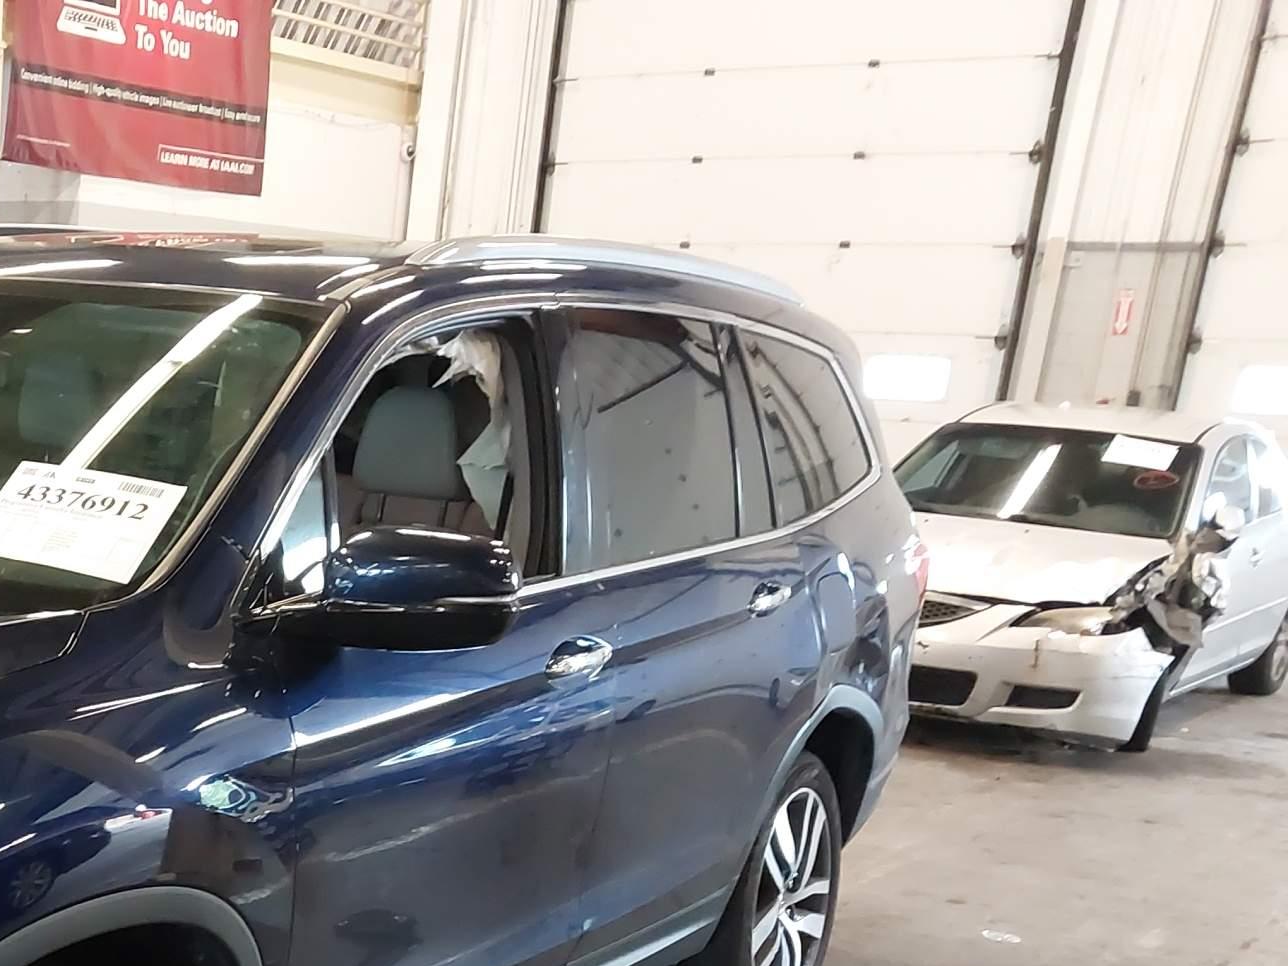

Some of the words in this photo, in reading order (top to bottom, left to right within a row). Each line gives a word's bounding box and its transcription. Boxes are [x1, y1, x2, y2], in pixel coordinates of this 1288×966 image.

[137, 0, 169, 21] The
[172, 0, 239, 38] Auction
[134, 23, 156, 52] To
[160, 29, 191, 60] You
[160, 151, 188, 166] LEARN
[188, 155, 210, 169] MORE
[209, 159, 221, 171] AT
[16, 482, 150, 521] 43376912
